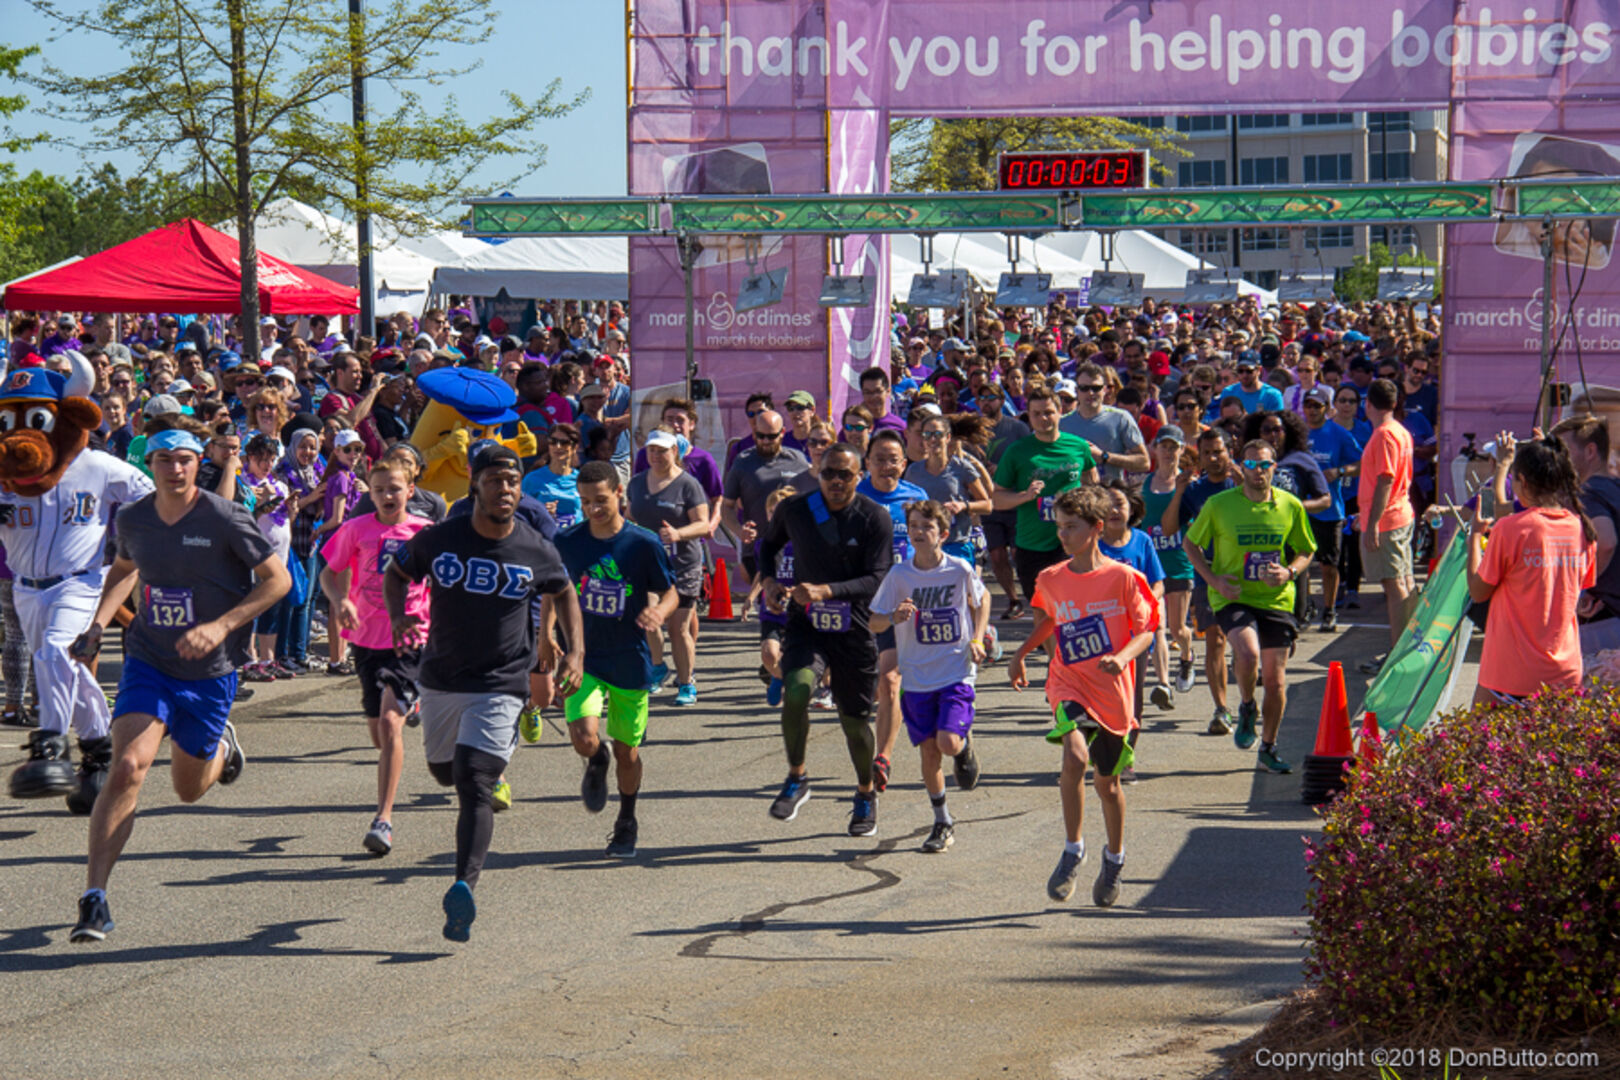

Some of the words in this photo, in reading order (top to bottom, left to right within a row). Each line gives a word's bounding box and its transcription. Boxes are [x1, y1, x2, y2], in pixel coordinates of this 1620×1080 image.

[692, 19, 869, 77] thank
[888, 35, 999, 91] you
[1020, 19, 1107, 77] for
[1129, 14, 1365, 85] helping
[1391, 7, 1612, 68] babies
[1007, 158, 1129, 187] 00:00:03
[649, 309, 705, 327] marh
[736, 309, 755, 327] of
[757, 309, 812, 327] dimes
[1454, 307, 1522, 327] march
[706, 332, 746, 346] march
[749, 332, 766, 346] for
[767, 332, 811, 346] babies
[1153, 534, 1176, 550] 154
[585, 593, 617, 614] 113
[912, 585, 956, 609] NIKE
[152, 604, 188, 627] 132
[811, 611, 842, 631] 193
[921, 623, 953, 642] 138
[1065, 633, 1103, 661] 130
